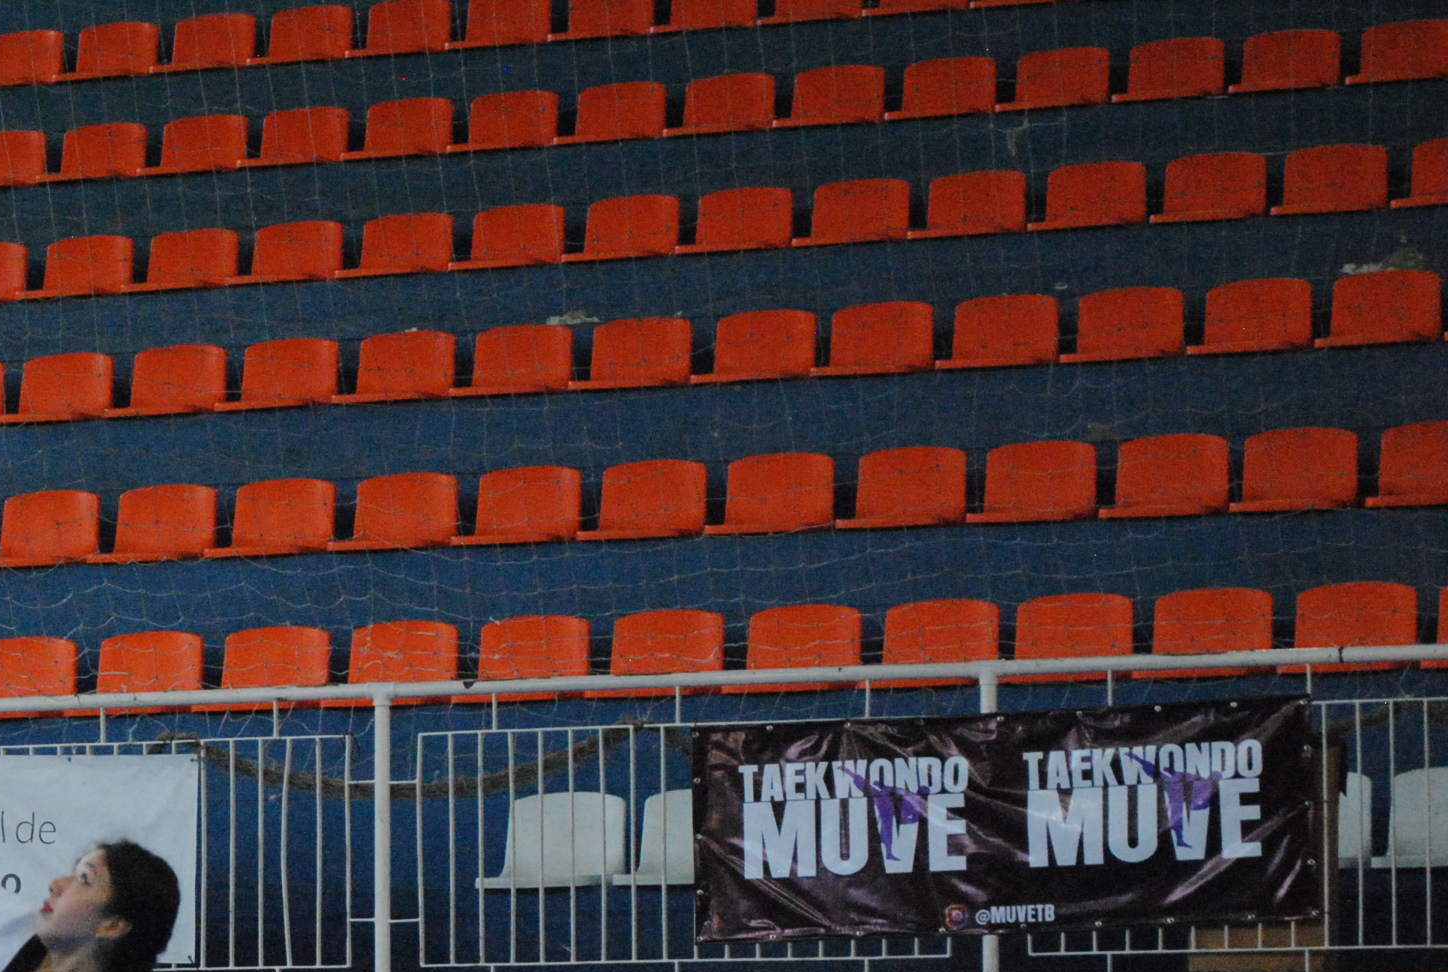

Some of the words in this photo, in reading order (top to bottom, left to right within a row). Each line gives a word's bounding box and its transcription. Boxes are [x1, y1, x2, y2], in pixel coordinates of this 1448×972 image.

[738, 756, 969, 803] TAEKWONDO
[1022, 739, 1263, 791] TAEKWONDO
[14, 811, 57, 845] de
[743, 792, 968, 880] MUVE
[1027, 777, 1263, 868] MUVE
[975, 903, 1056, 925] @MUVETB
